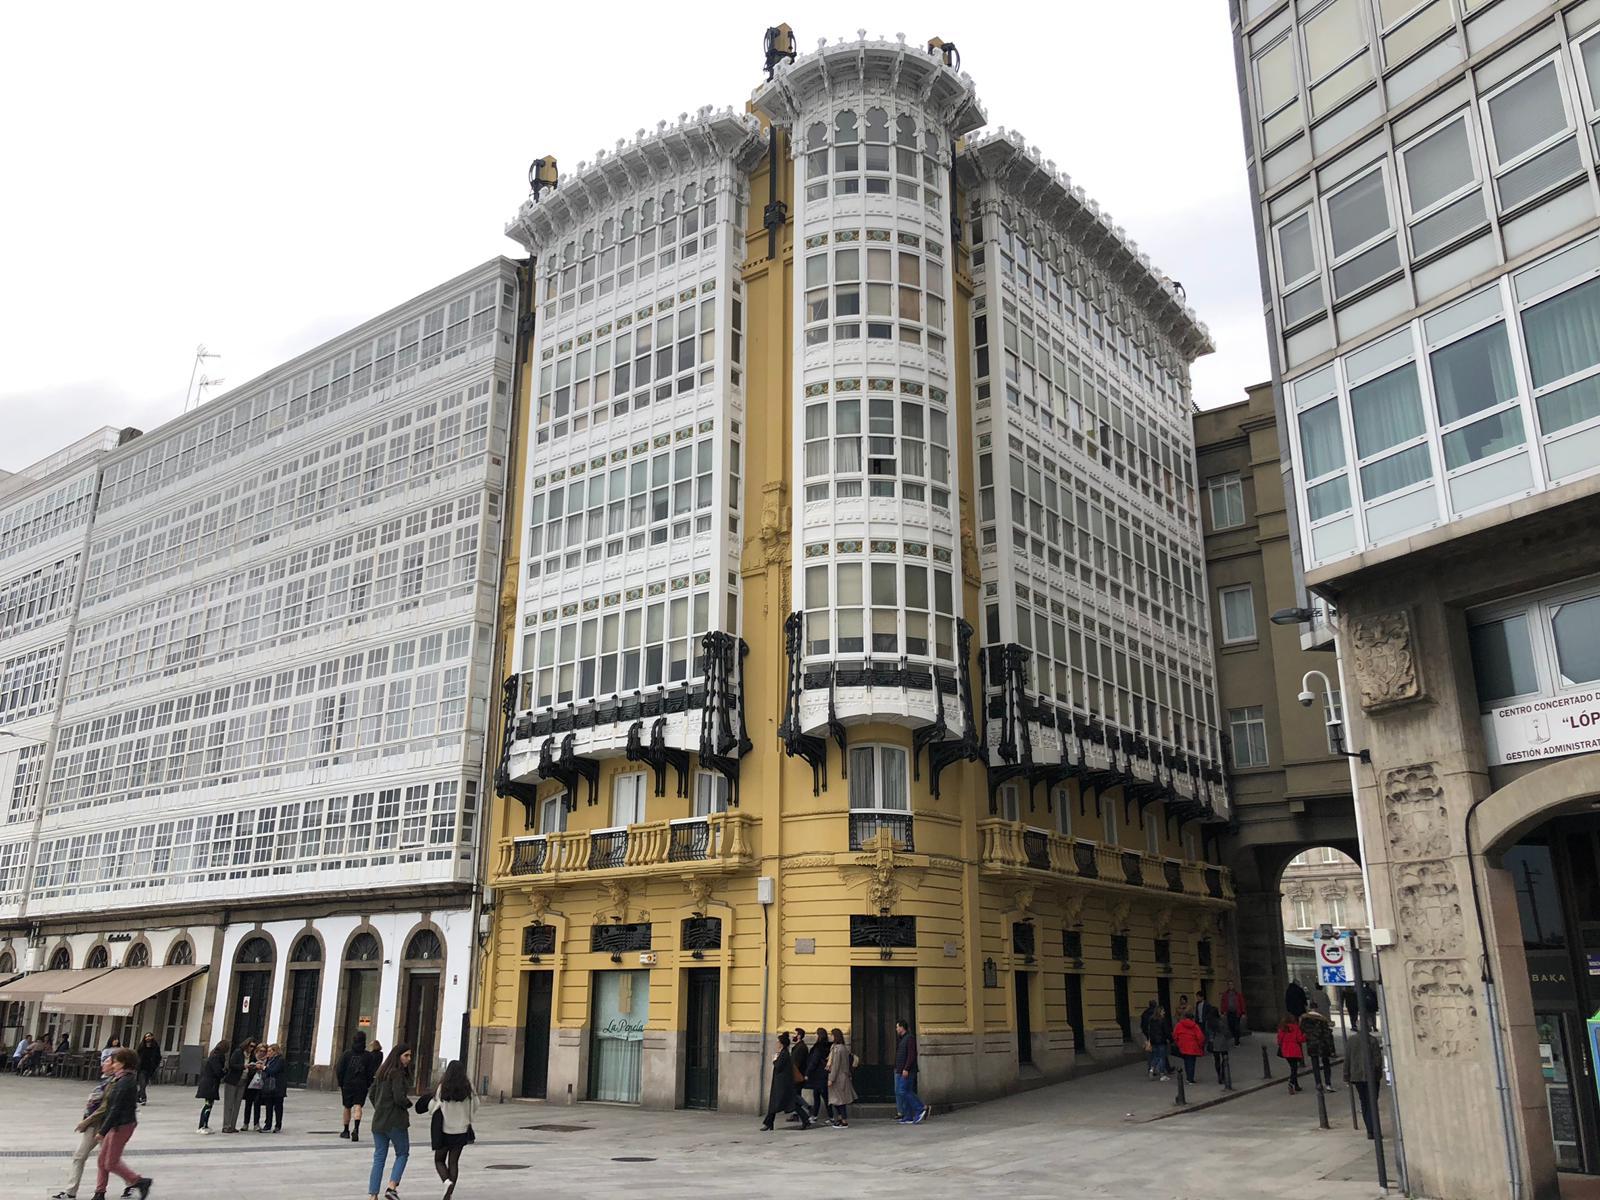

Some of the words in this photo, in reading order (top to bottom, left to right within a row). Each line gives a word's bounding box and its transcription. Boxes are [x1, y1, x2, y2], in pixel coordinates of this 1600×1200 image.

[1499, 705, 1532, 718] CENTRO
[1534, 693, 1593, 712] CONCERTADO
[1506, 747, 1541, 761] GESTIÓN
[1531, 974, 1566, 983] BAKA
